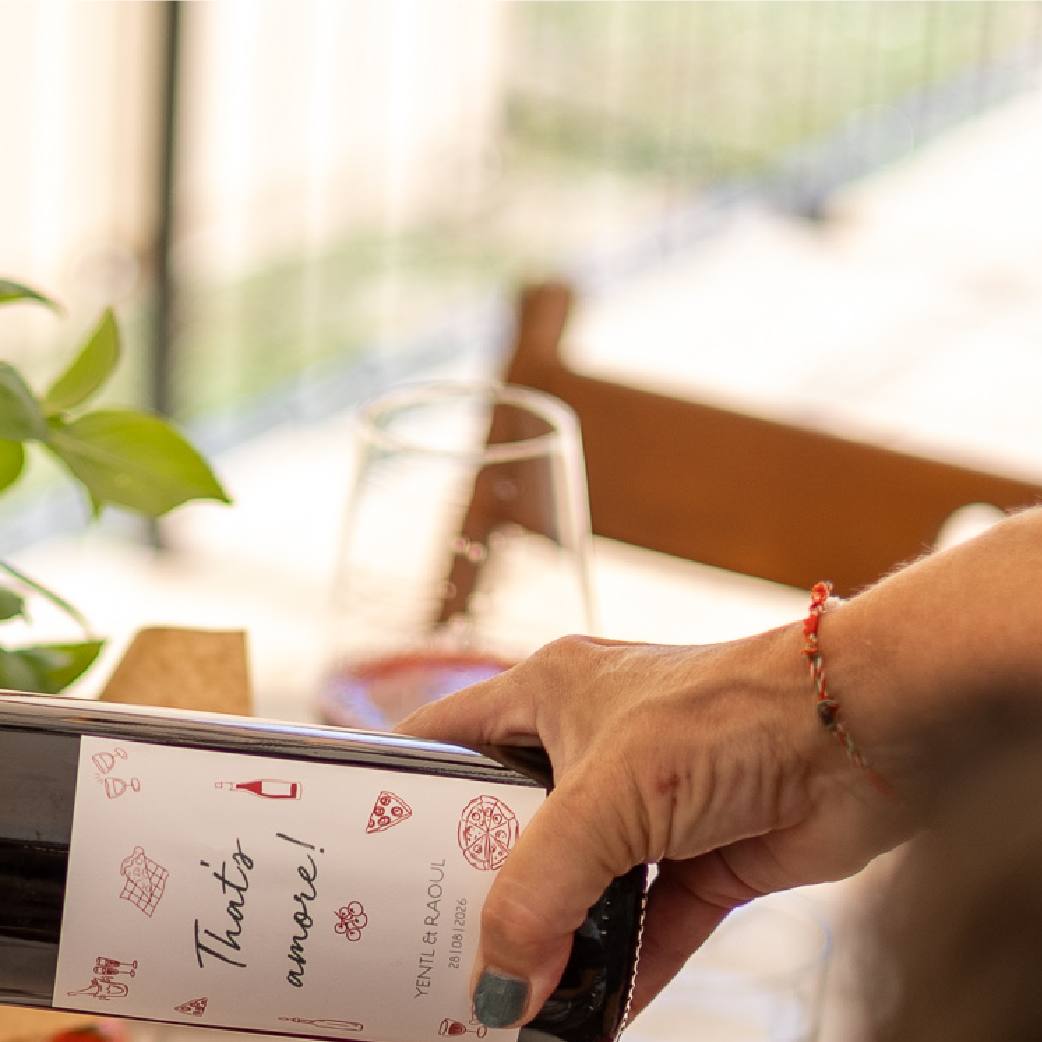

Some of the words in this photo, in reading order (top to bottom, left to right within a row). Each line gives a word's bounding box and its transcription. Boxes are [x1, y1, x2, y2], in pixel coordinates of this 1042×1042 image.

[194, 837, 255, 969] That's
[275, 832, 326, 989] amore!
[424, 858, 446, 926] RAOUL
[422, 931, 438, 945] &
[414, 949, 435, 1000] YENTL
